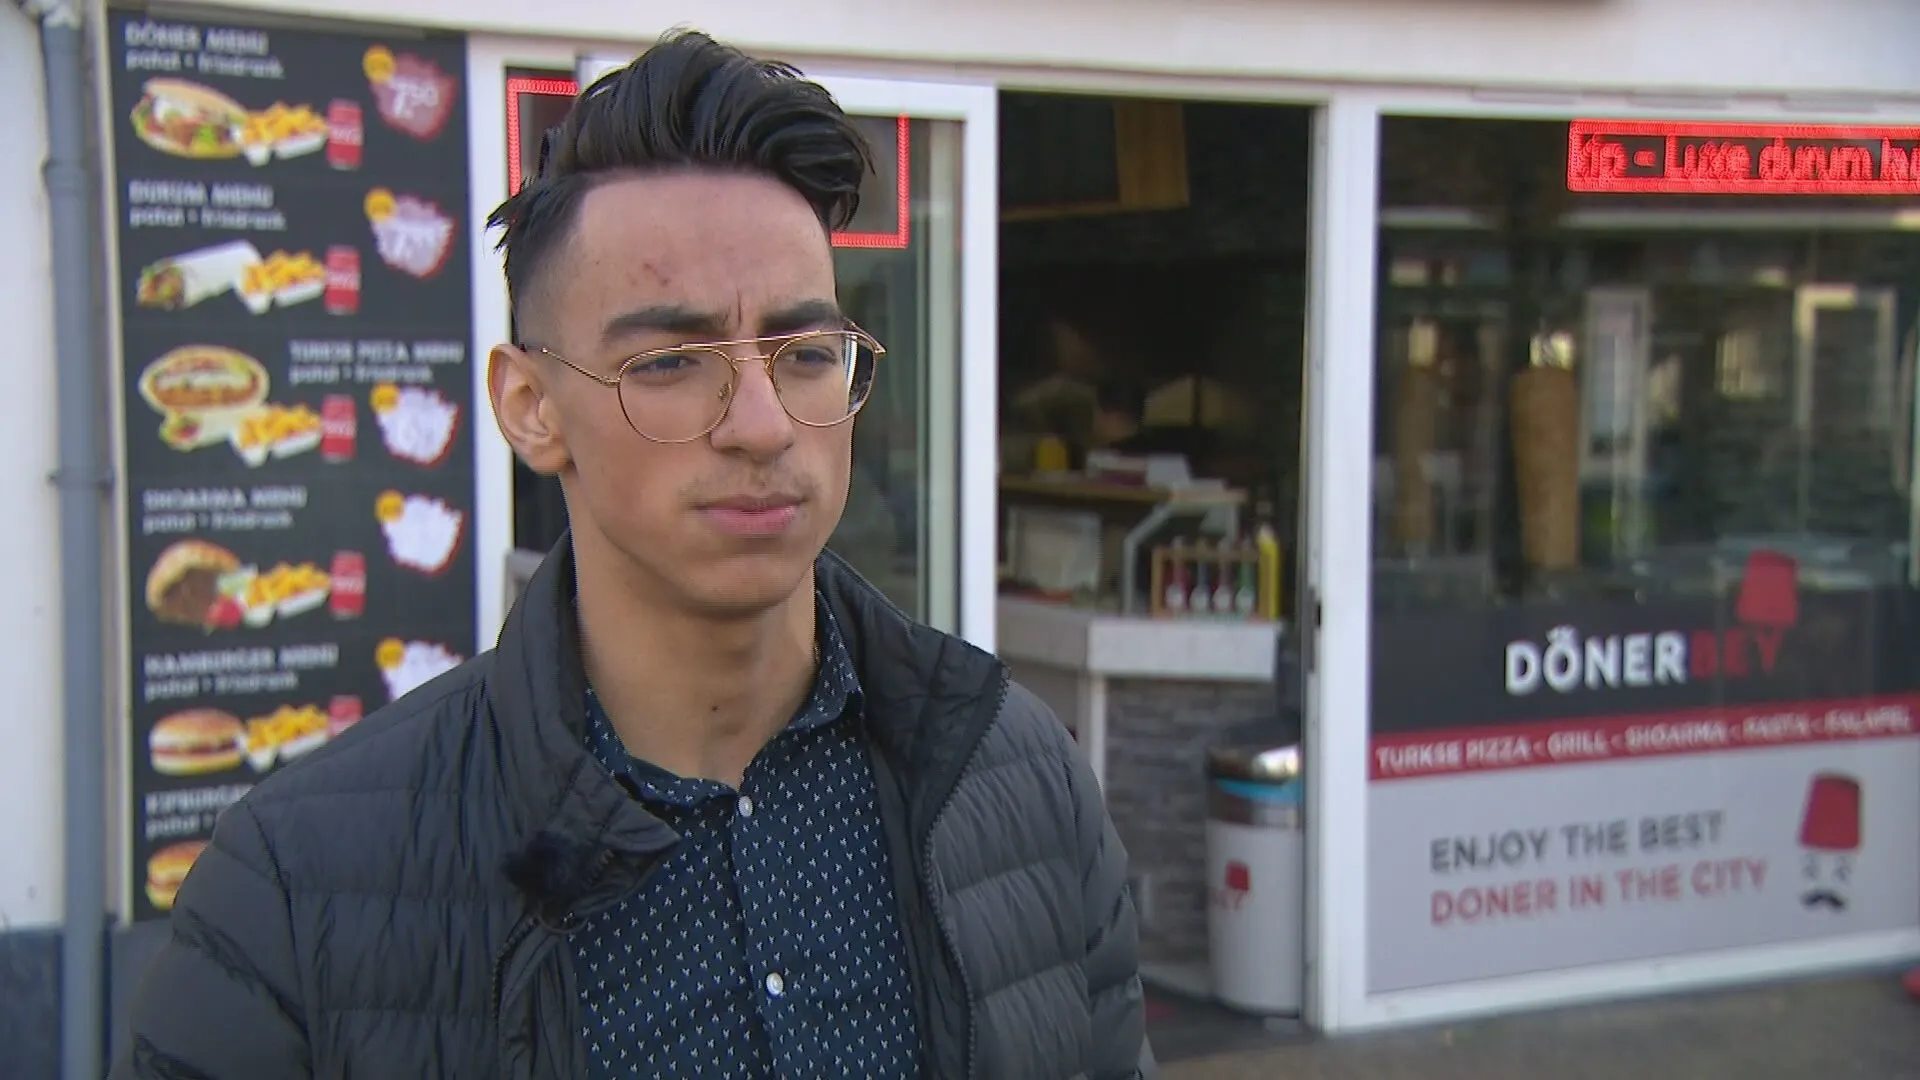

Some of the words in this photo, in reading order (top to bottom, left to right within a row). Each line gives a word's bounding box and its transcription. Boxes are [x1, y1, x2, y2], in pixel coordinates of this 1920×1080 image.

[1376, 740, 1462, 771] TURKSE
[1466, 736, 1531, 764] PIZZA
[1547, 728, 1611, 760] GRILL
[1429, 826, 1551, 873] ENJOY
[1558, 818, 1628, 858] THE
[1638, 808, 1726, 851] BEST
[1429, 877, 1558, 926] DONER
[1566, 873, 1606, 908] IN
[1614, 862, 1681, 901] THE
[1690, 857, 1767, 897] CITY
